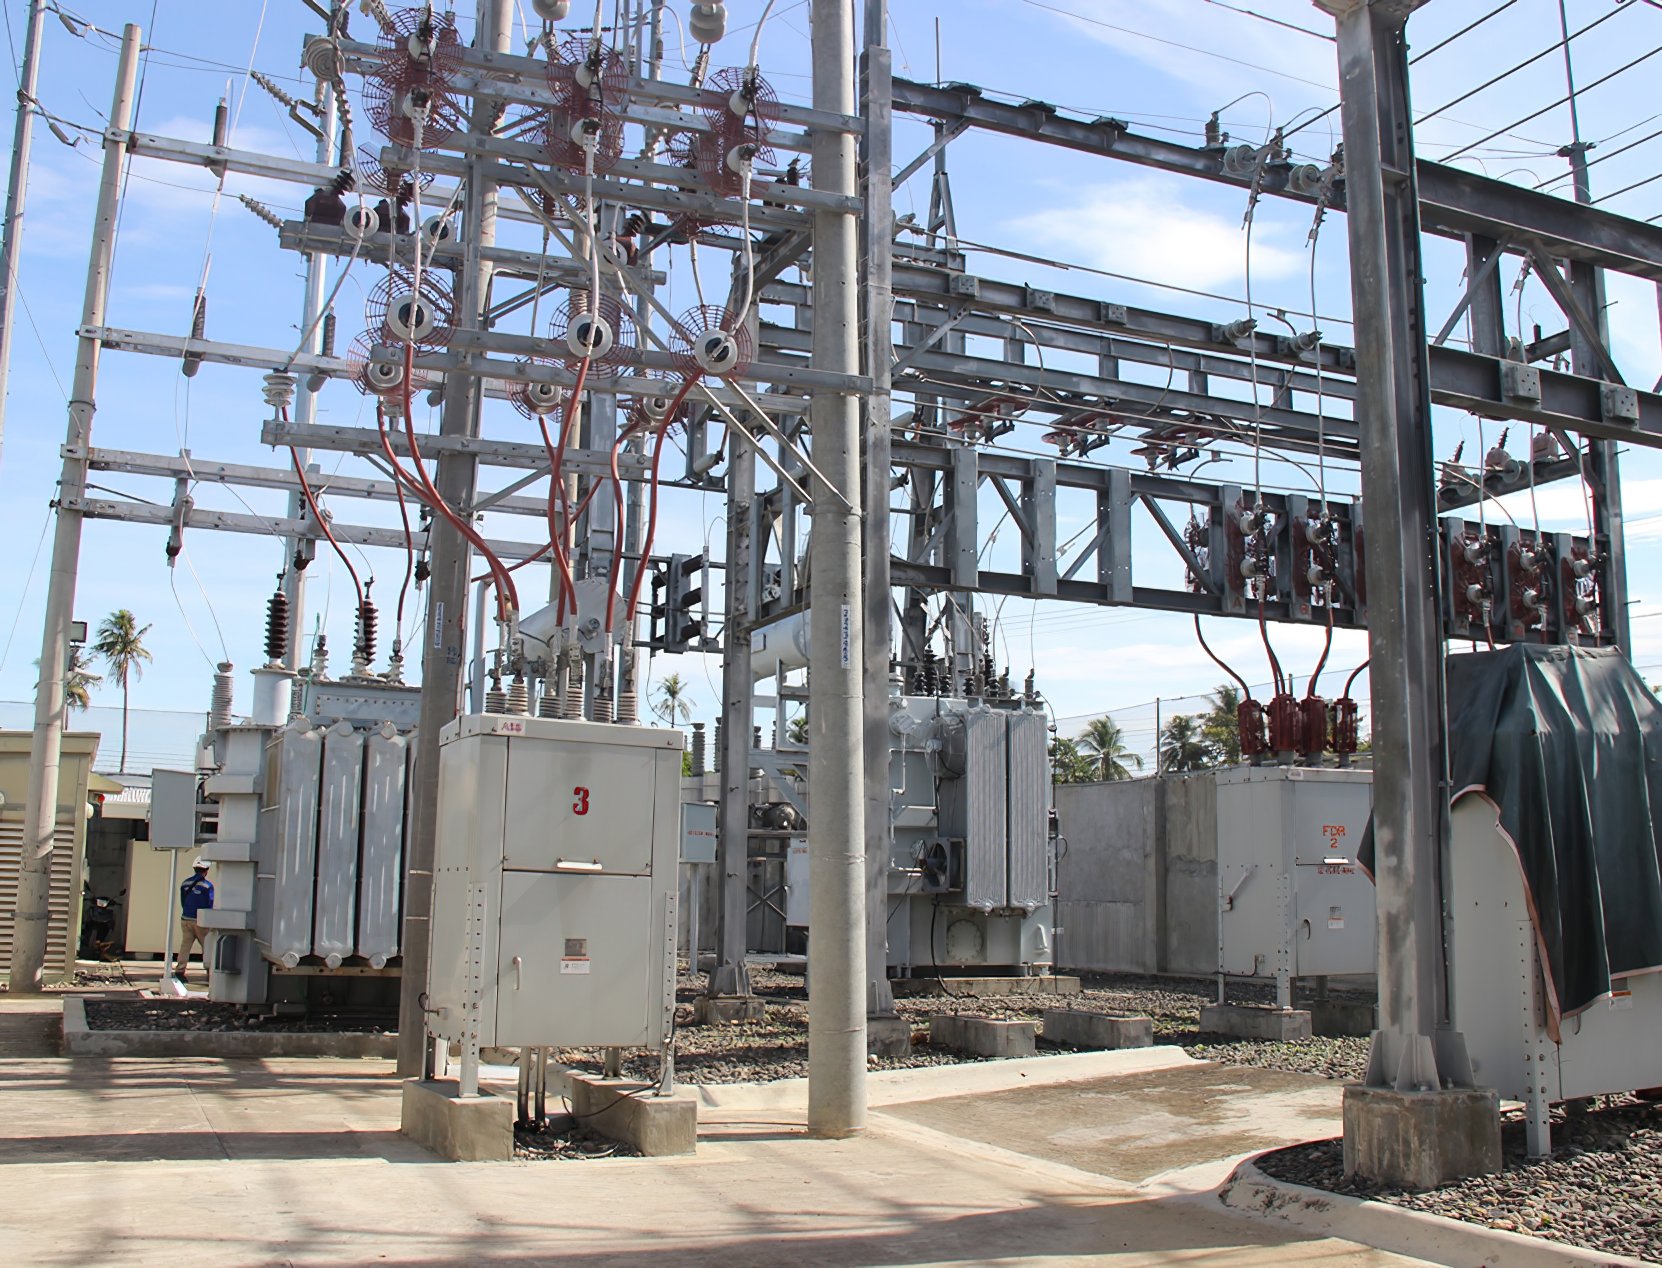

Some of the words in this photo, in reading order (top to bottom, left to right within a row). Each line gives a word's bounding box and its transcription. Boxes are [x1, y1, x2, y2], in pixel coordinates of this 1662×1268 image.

[573, 786, 590, 816] 3
[1322, 825, 1346, 836] FDR
[1330, 838, 1338, 849] 2
